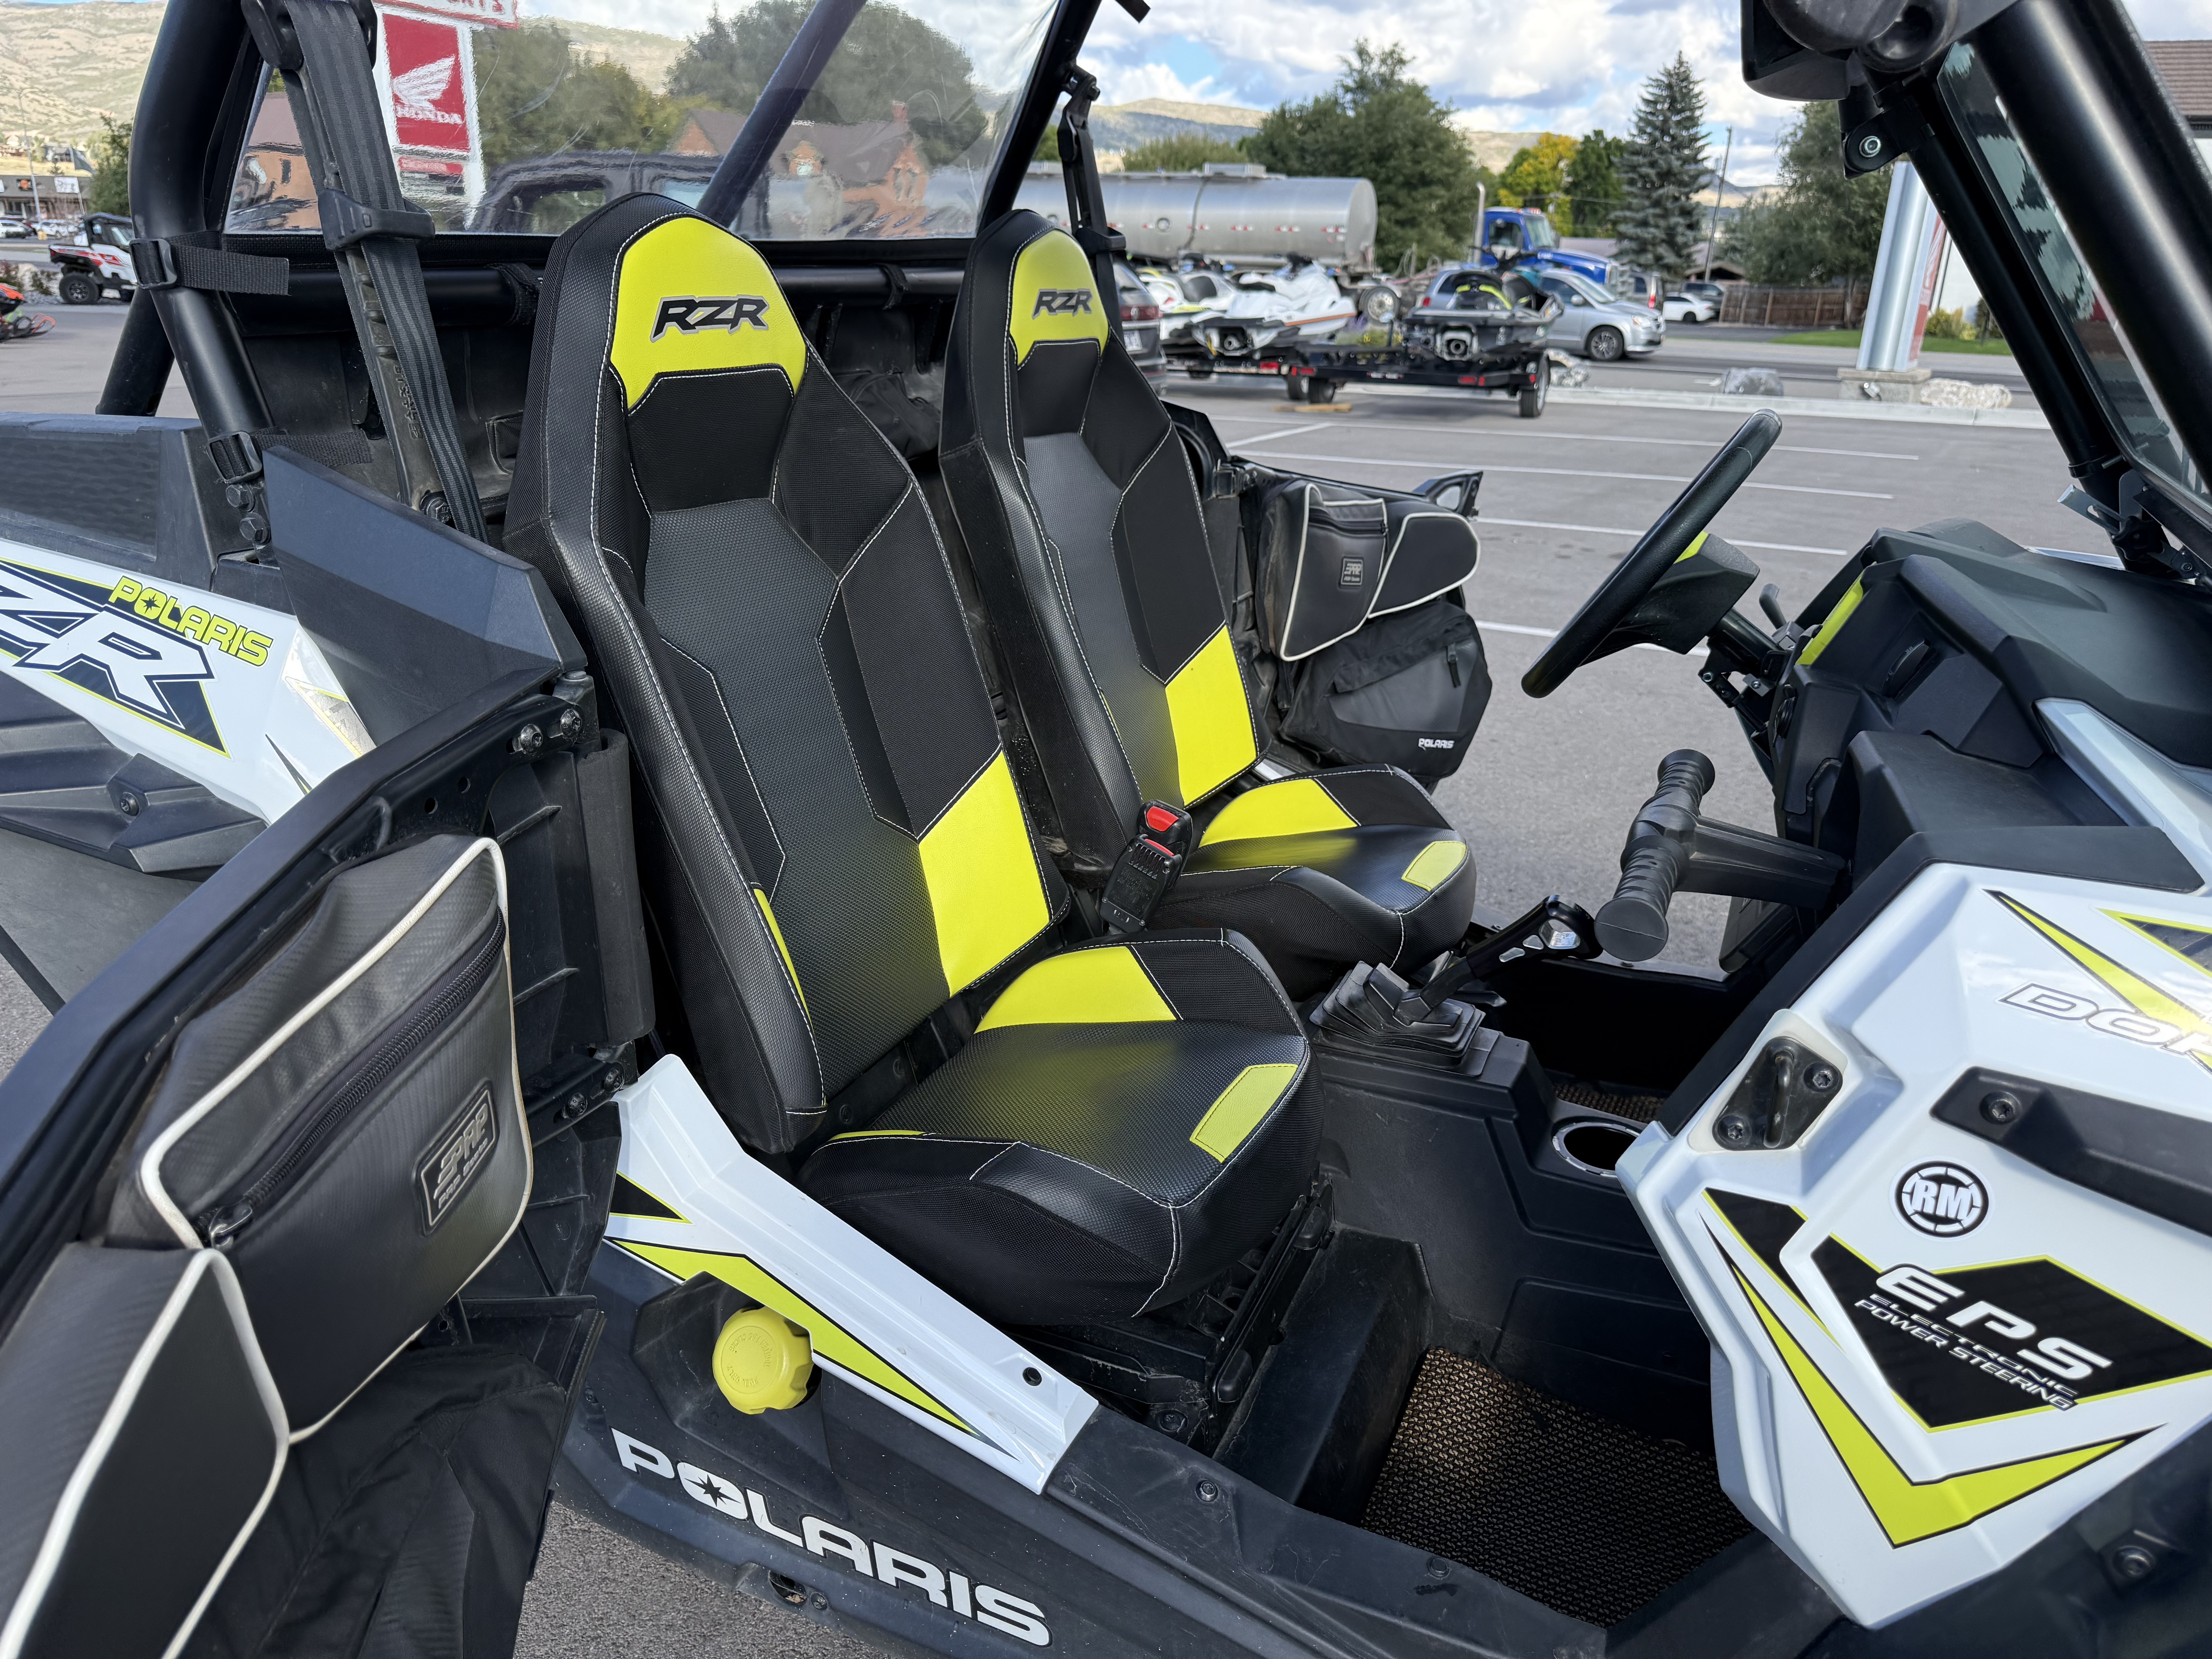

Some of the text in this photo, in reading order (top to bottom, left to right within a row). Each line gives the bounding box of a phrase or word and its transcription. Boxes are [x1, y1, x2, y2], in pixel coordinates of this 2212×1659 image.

[650, 294, 769, 343] RZR
[1032, 289, 1093, 319] RZR
[108, 577, 274, 668] POLARIS
[1418, 738, 1455, 749] POLARIS
[1911, 1178, 1973, 1221] RM
[1854, 1299, 2076, 1408] POWER STEERING
[1869, 1293, 2078, 1398] ELECTRONIC
[1876, 1265, 2115, 1381] EPS
[727, 1366, 740, 1383] ONLY
[611, 1427, 1052, 1647] POLARIS
